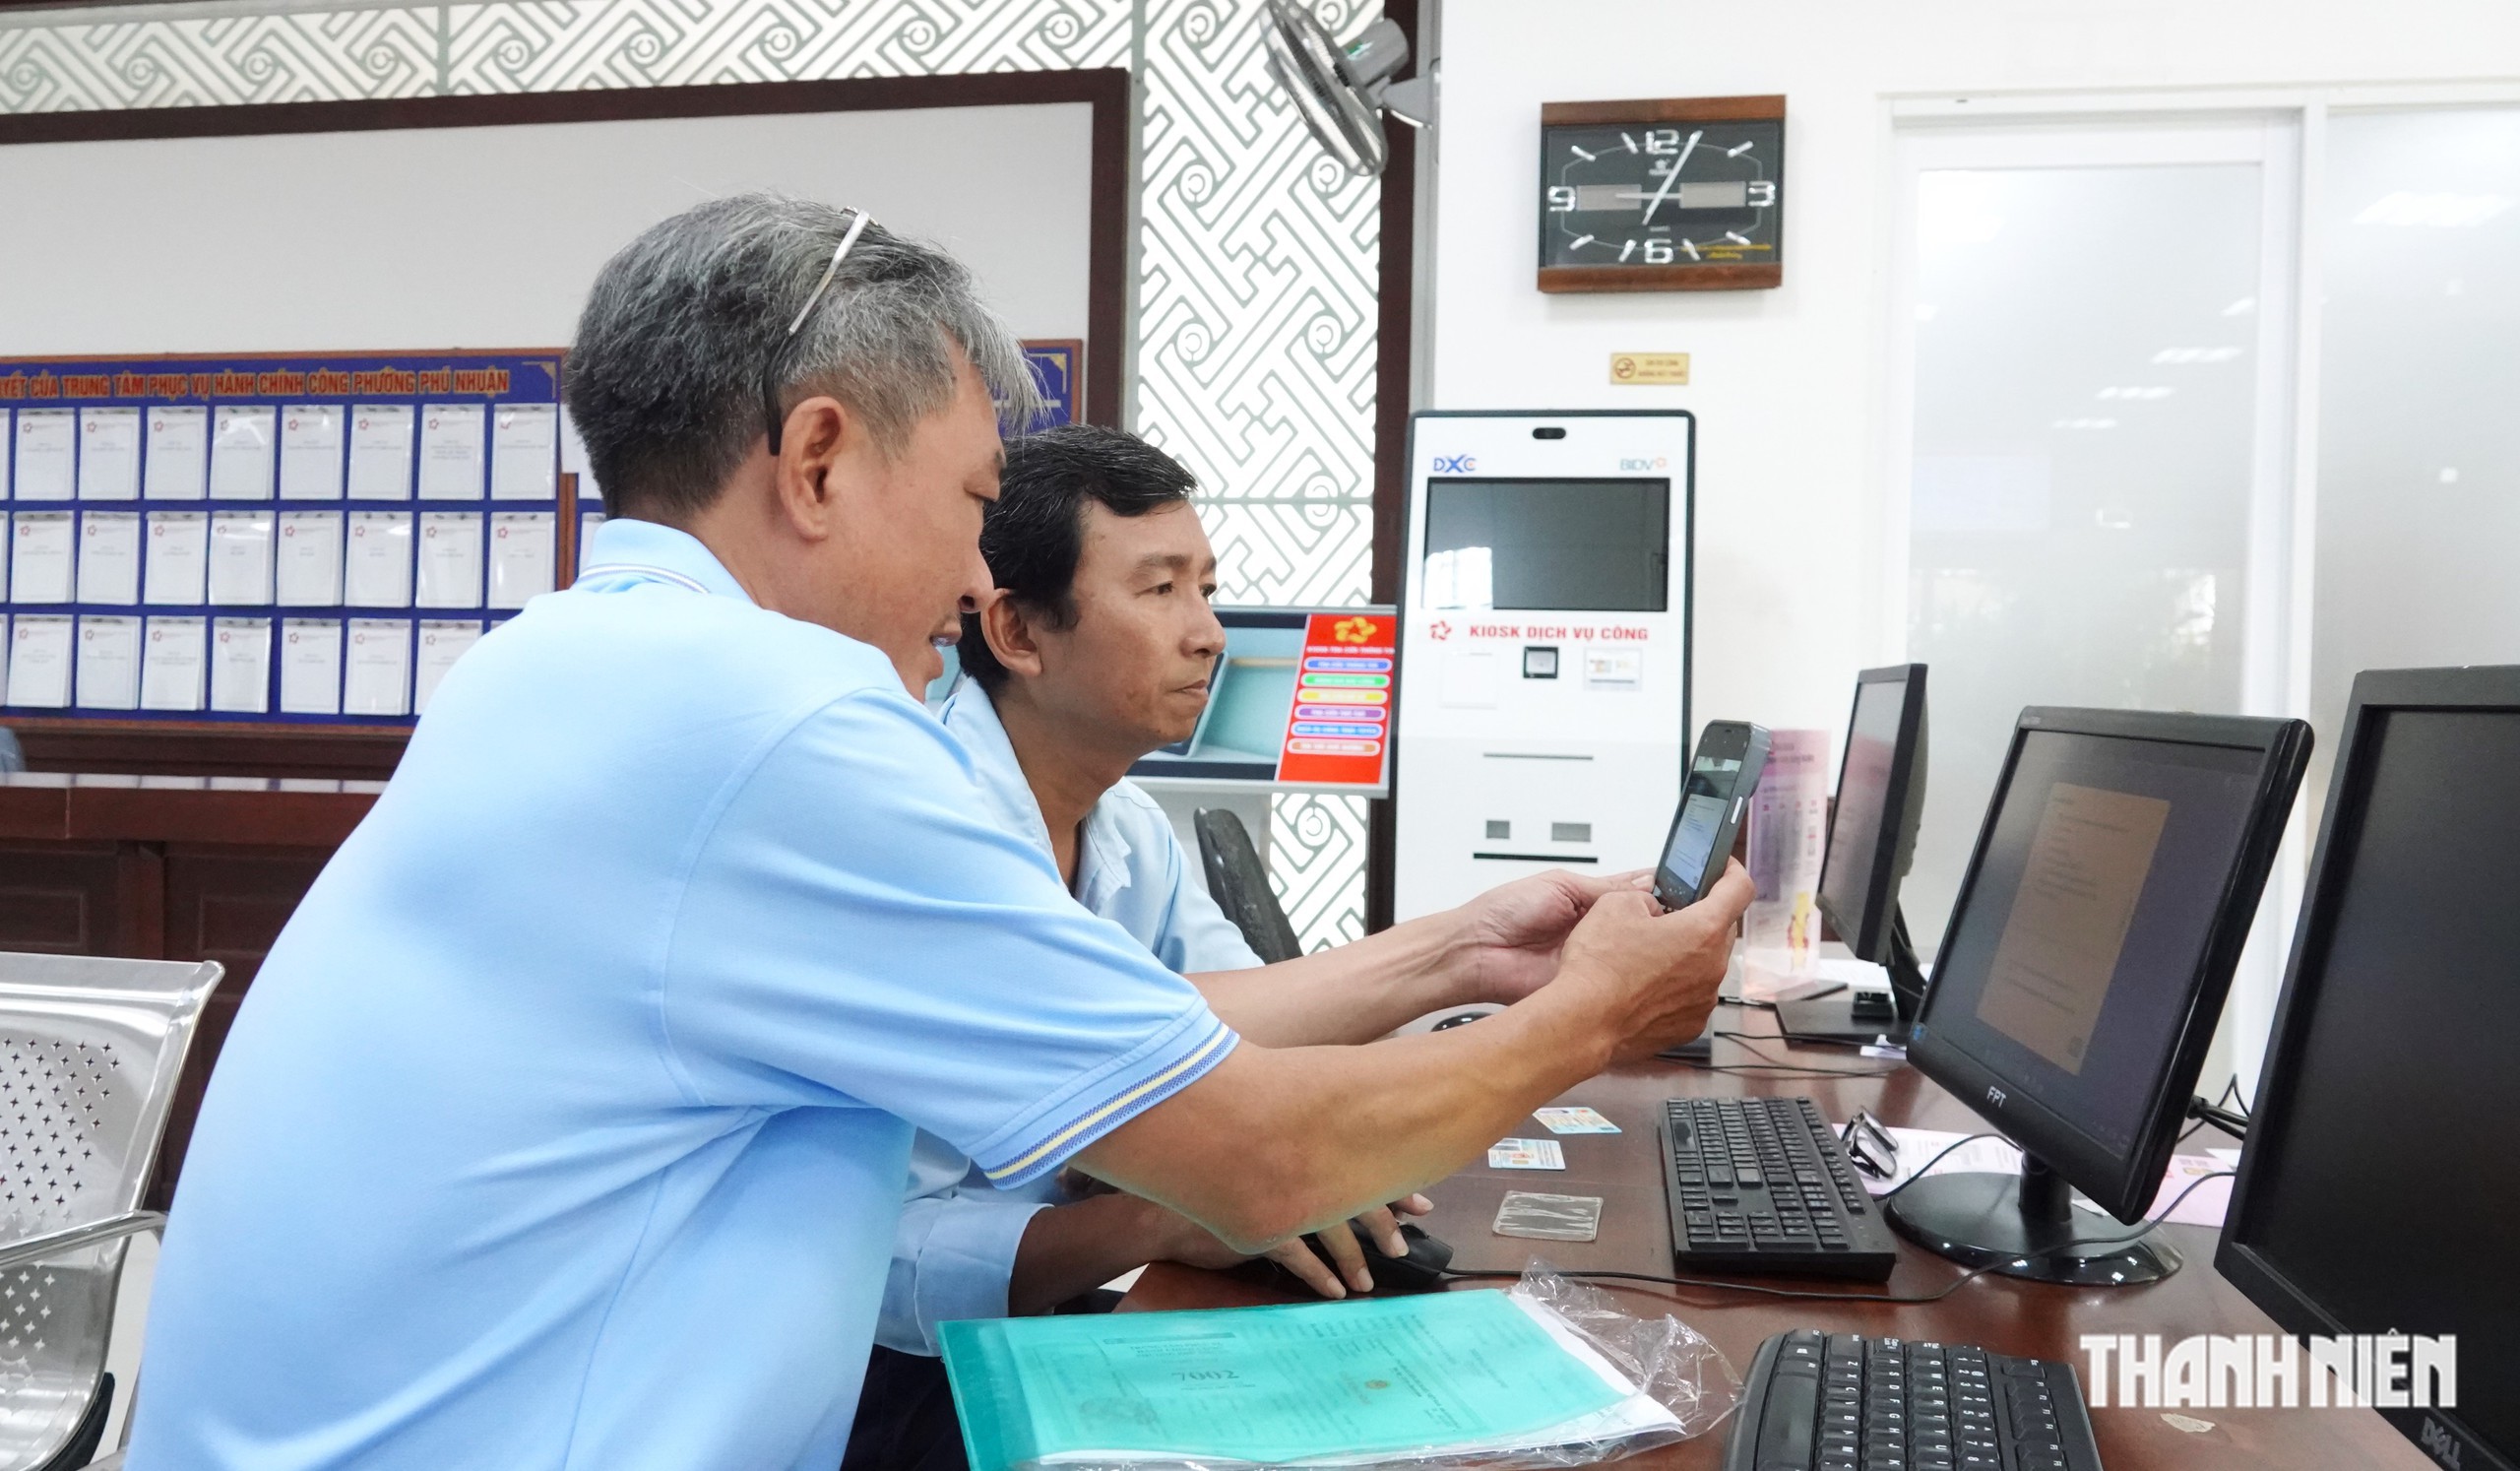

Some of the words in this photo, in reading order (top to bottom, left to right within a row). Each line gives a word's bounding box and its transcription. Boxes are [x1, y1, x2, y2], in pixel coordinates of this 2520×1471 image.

[1645, 129, 1679, 156] 12
[1547, 185, 1576, 212] 9
[1747, 180, 1776, 207] 3
[1644, 238, 1674, 264] 6
[61, 374, 111, 398] TRUNG
[112, 369, 146, 397] TÂM
[148, 373, 188, 401] PHỤC
[190, 372, 212, 401] VỤ
[213, 368, 256, 396] HÀNH
[257, 367, 305, 396] CHÍNH
[306, 367, 349, 396] CÔNG
[351, 365, 415, 395] PHƯỜNG
[418, 365, 451, 394] PHÚ
[453, 365, 510, 398] NHUẬN
[1433, 454, 1477, 474] DXC
[1619, 458, 1655, 472] BIDV
[1470, 625, 1520, 638] KIOSK
[1527, 626, 1566, 640] DỊCH
[1572, 627, 1595, 641] VỤ
[1601, 625, 1648, 640] CÔNG
[1986, 1085, 2007, 1108] FPT
